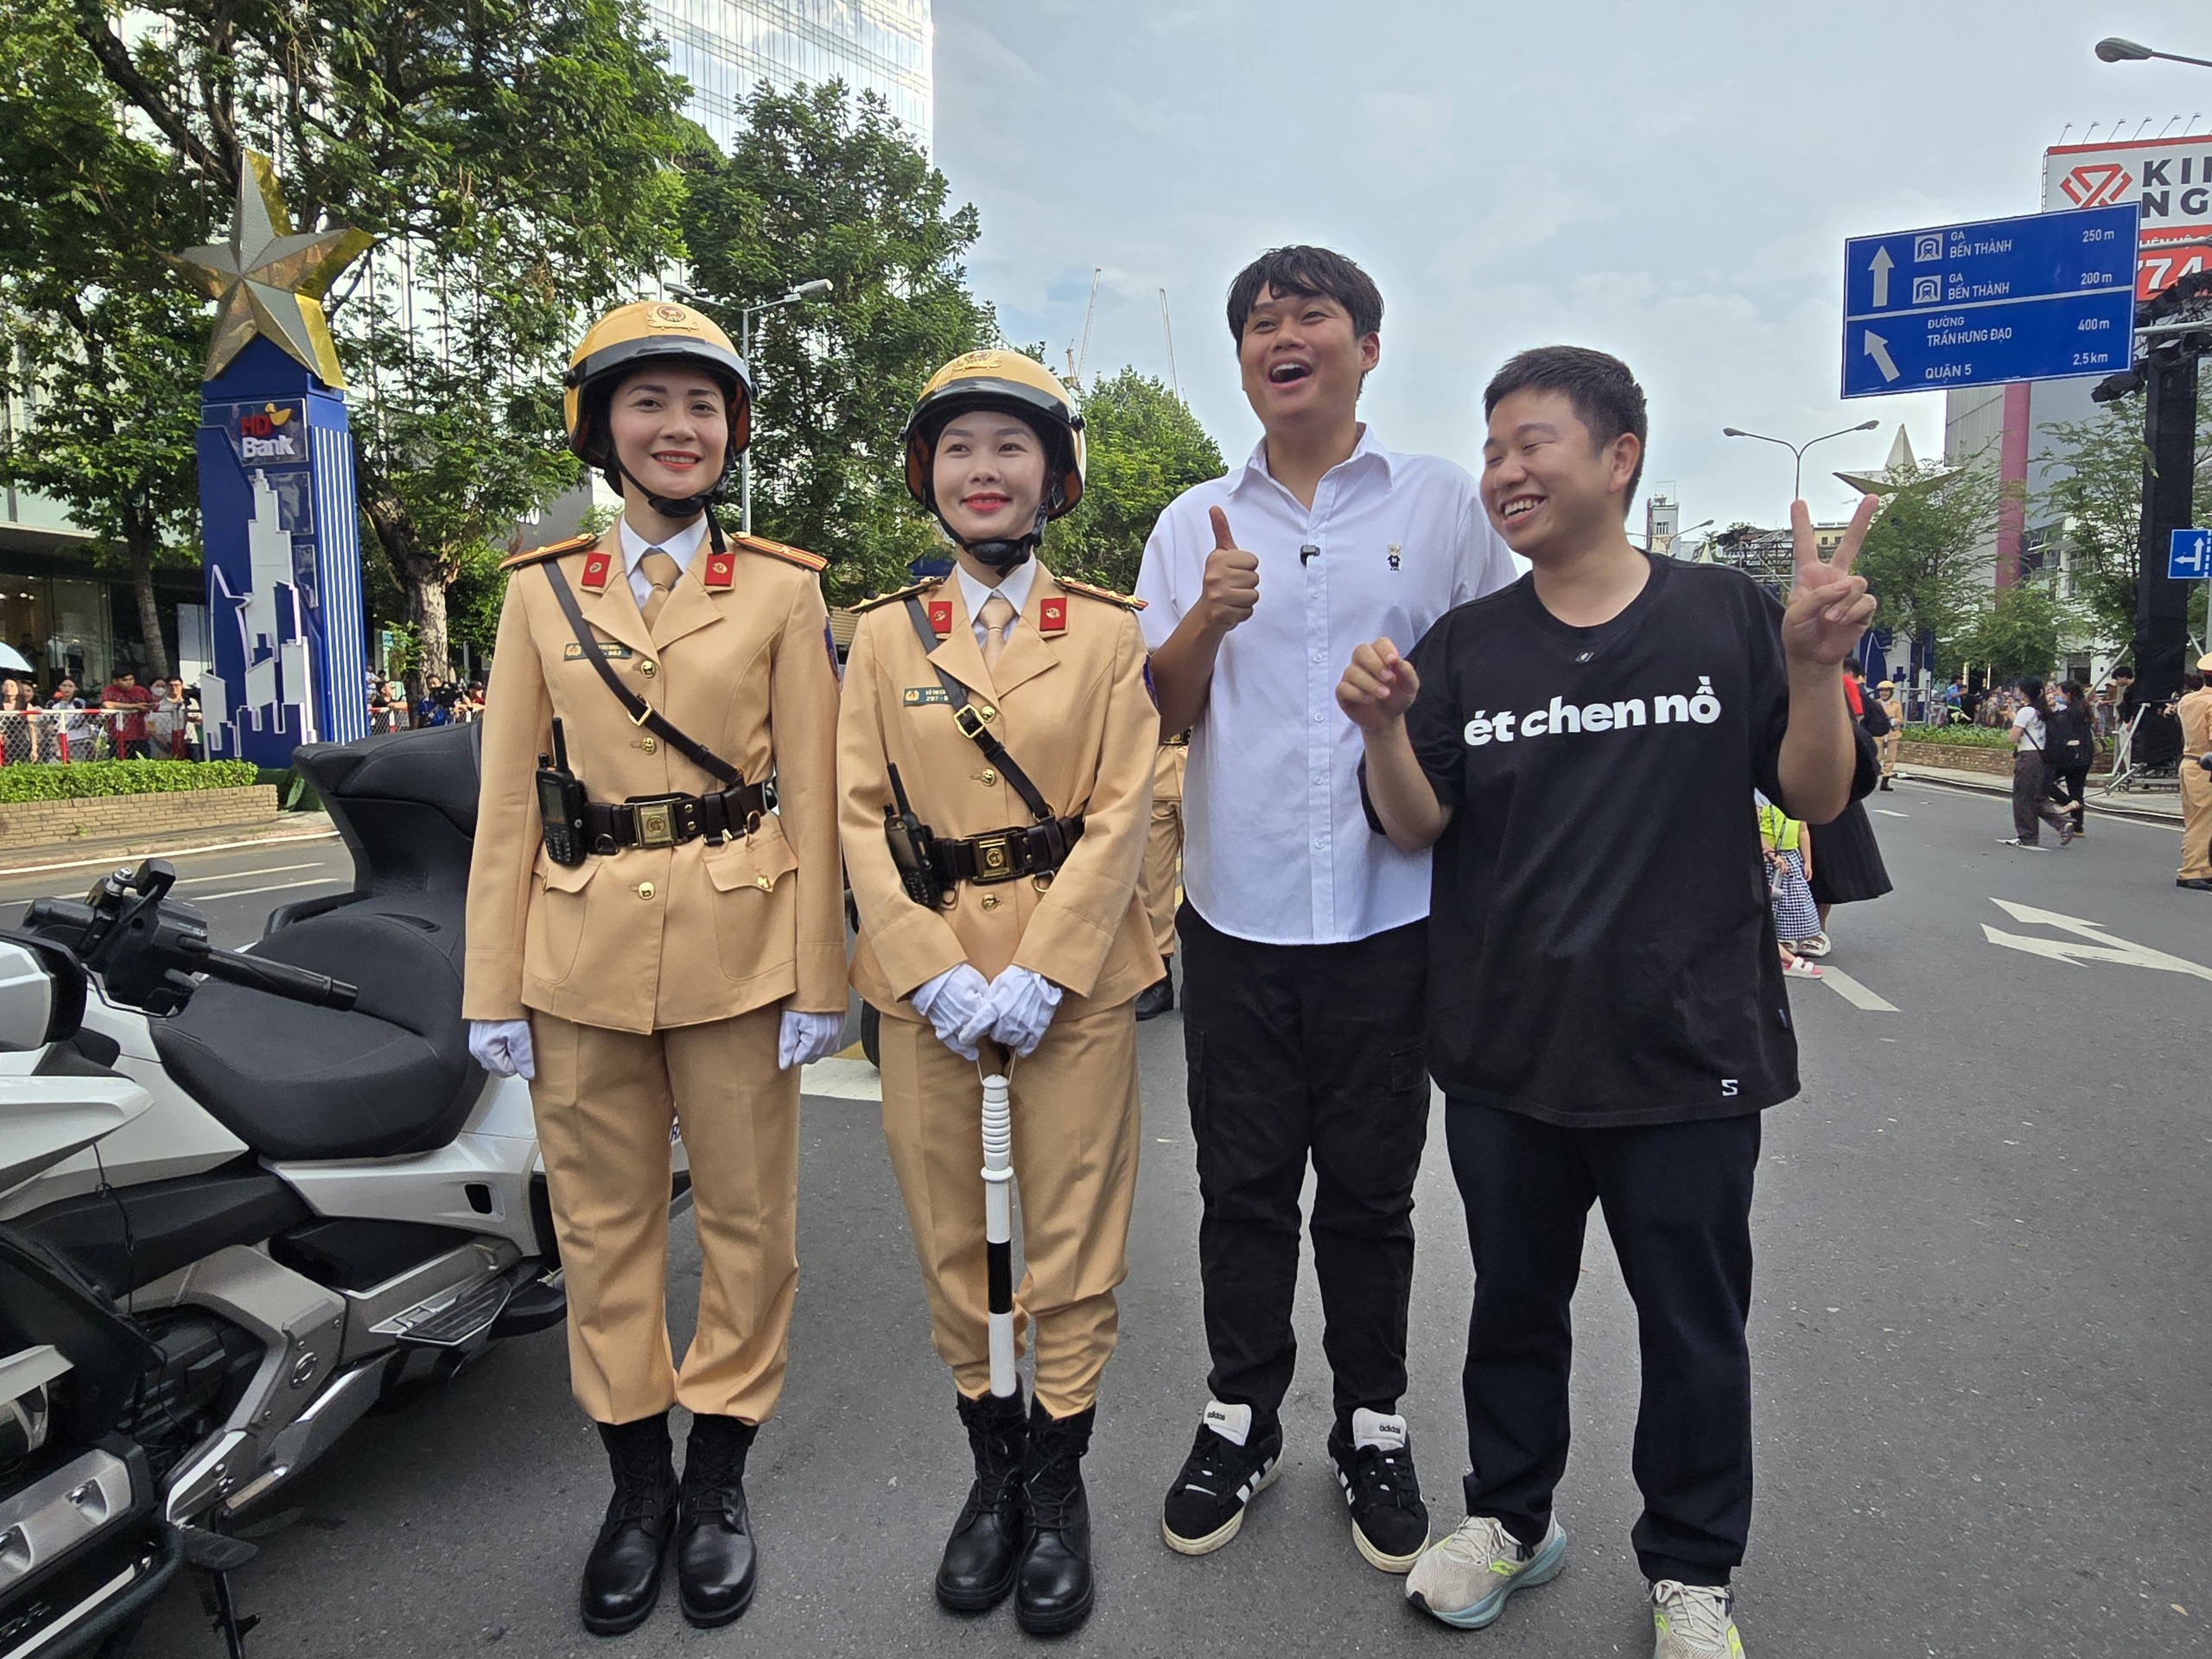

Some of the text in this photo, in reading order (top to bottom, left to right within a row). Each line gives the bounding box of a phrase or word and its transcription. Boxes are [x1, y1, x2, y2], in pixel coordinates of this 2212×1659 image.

[1950, 231, 1966, 241] GA
[2082, 229, 2114, 243] 250 m
[1949, 238, 2012, 259] BẾN THÀNH
[1948, 272, 1964, 283] GA
[2081, 271, 2113, 285] 200 m
[1948, 280, 2011, 300] BẾN THÀNH
[1927, 315, 1965, 329] ĐƯỜNG
[2077, 318, 2110, 331] 400 m
[1957, 329, 1988, 344] HƯNG
[1990, 327, 2012, 343] ĐẠO
[2090, 352, 2108, 364] km
[1924, 363, 1972, 385] QUẬN 5
[240, 415, 271, 435] HD
[242, 435, 296, 458] Bank
[1464, 710, 1516, 746] ét
[1521, 696, 1647, 738] chen
[1379, 1424, 1402, 1435] adidas
